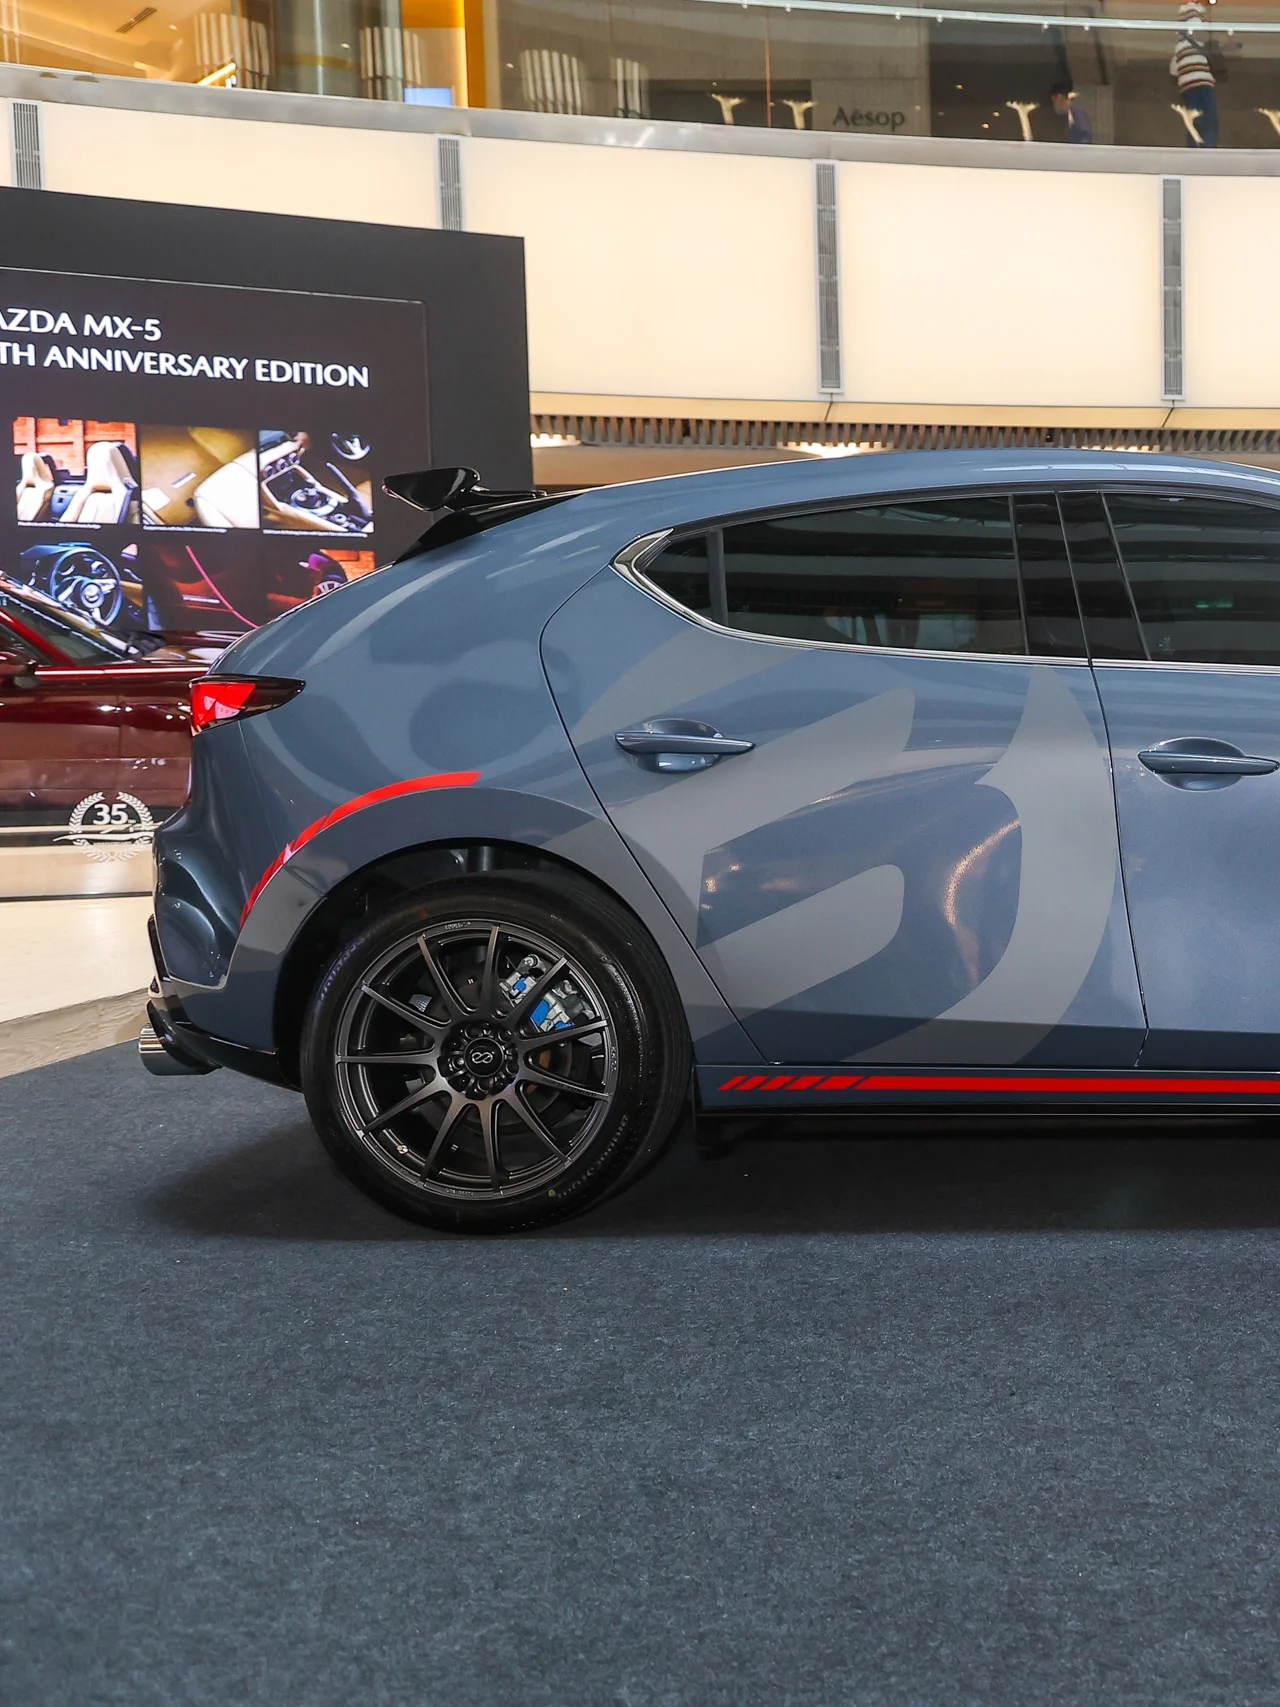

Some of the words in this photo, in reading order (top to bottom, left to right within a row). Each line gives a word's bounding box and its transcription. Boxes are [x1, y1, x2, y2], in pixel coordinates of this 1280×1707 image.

[83, 313, 162, 342] MX-5
[43, 344, 249, 381] ANNIVERSARY
[255, 358, 370, 389] EDITION
